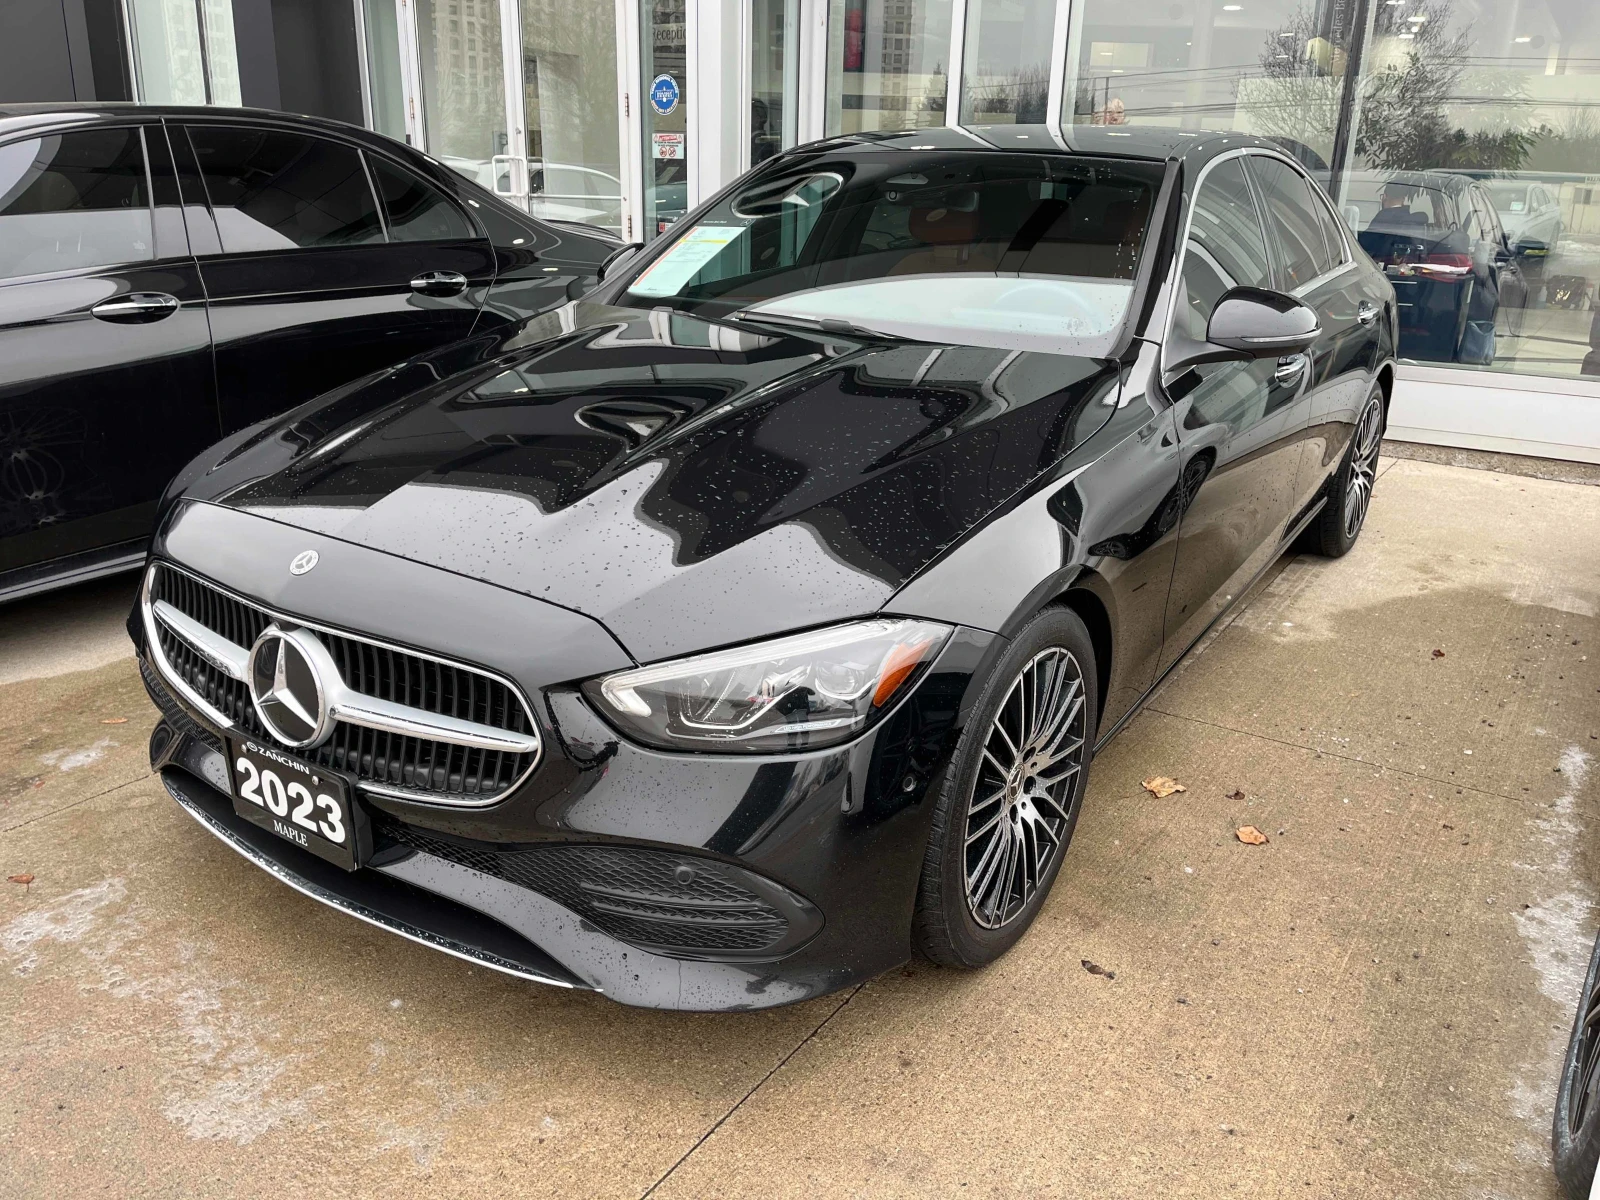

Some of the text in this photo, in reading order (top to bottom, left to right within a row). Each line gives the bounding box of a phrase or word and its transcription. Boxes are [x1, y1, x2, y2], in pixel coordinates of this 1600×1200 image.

[257, 746, 310, 775] ZANCHIN
[236, 757, 346, 844] 2023
[273, 819, 308, 847] MAPLE
